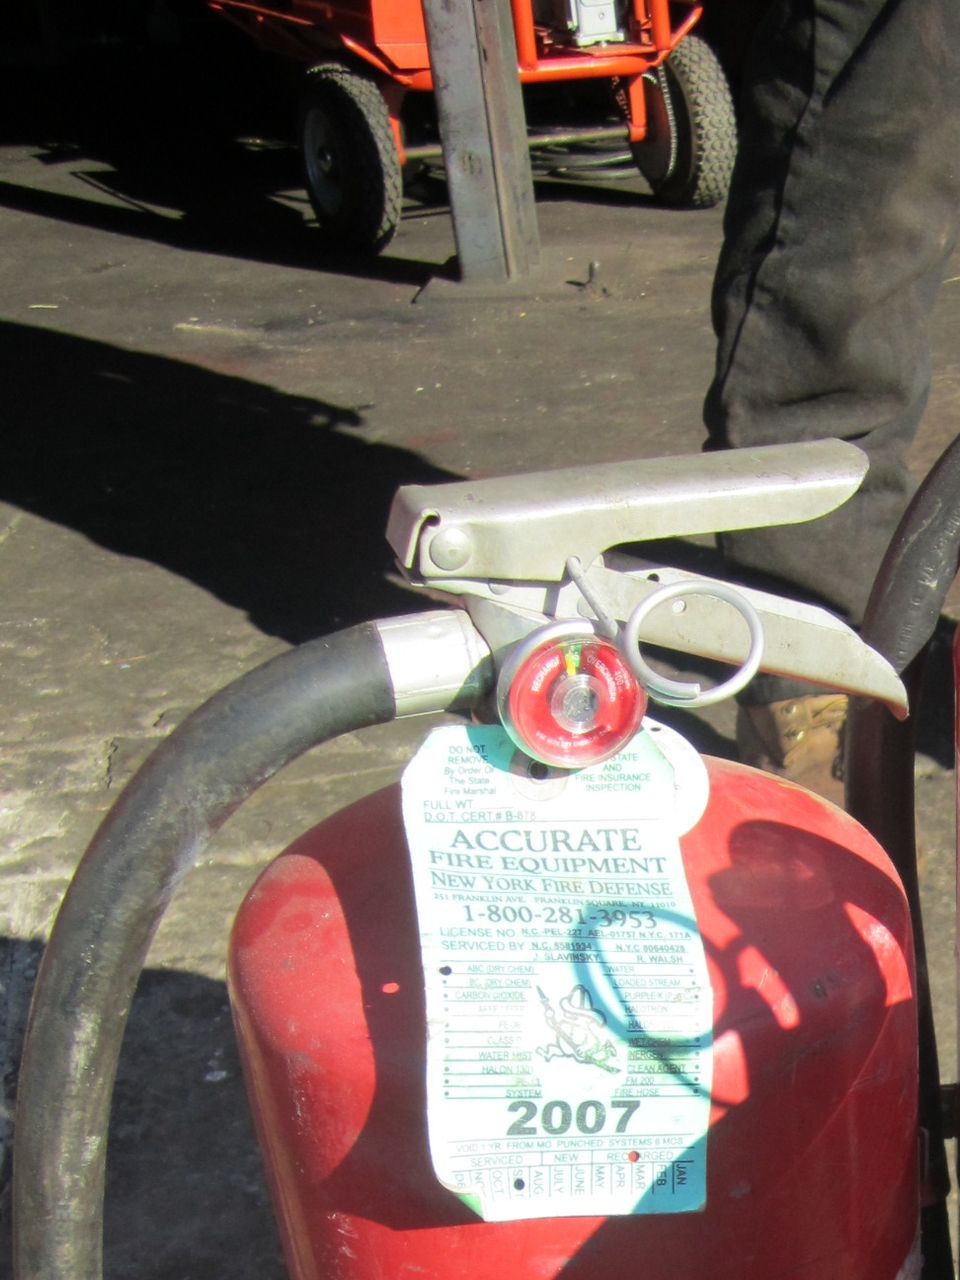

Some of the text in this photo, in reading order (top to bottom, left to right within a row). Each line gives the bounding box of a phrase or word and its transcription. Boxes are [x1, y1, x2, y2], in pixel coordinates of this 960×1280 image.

[449, 744, 486, 755] DO NOT
[448, 755, 488, 765] REMOVE
[457, 766, 481, 775] Order
[603, 763, 622, 772] AND
[468, 777, 490, 785] State
[575, 773, 652, 782] FIRE INSURANCE
[463, 786, 496, 795] Marshal
[585, 783, 641, 792] INSPECTION
[423, 800, 451, 810] FULL
[448, 828, 643, 853] ACCURATE
[429, 850, 667, 876] FIRE EQUIPMENT
[430, 871, 673, 896] NEW YORK FIRE DEFENSE
[451, 893, 503, 903] FRANKLIN
[463, 904, 658, 929] 1-800-281-3953
[439, 927, 493, 938] LICENSE
[441, 940, 524, 951] SERVICED BY
[544, 952, 684, 962] SLAVINSKY WALSH
[455, 991, 490, 1000] CARBON
[478, 1051, 509, 1060] WATER
[627, 1064, 656, 1073] CLEAN
[505, 1089, 542, 1099] SYSTEM
[614, 1087, 660, 1097] FIRE HOSE
[506, 1100, 641, 1136] 2007
[506, 1137, 651, 1150] FROM SYSTEMS
[471, 1155, 524, 1168] SERVICED
[554, 1153, 579, 1162] NEW
[553, 1167, 564, 1194] JULY
[574, 1166, 585, 1195] JUNE
[594, 1165, 605, 1188] MAY
[615, 1164, 626, 1188] APR
[635, 1164, 646, 1189] MAR
[656, 1164, 667, 1186] FEB
[676, 1164, 687, 1186] JAN
[533, 1170, 544, 1195] AUG
